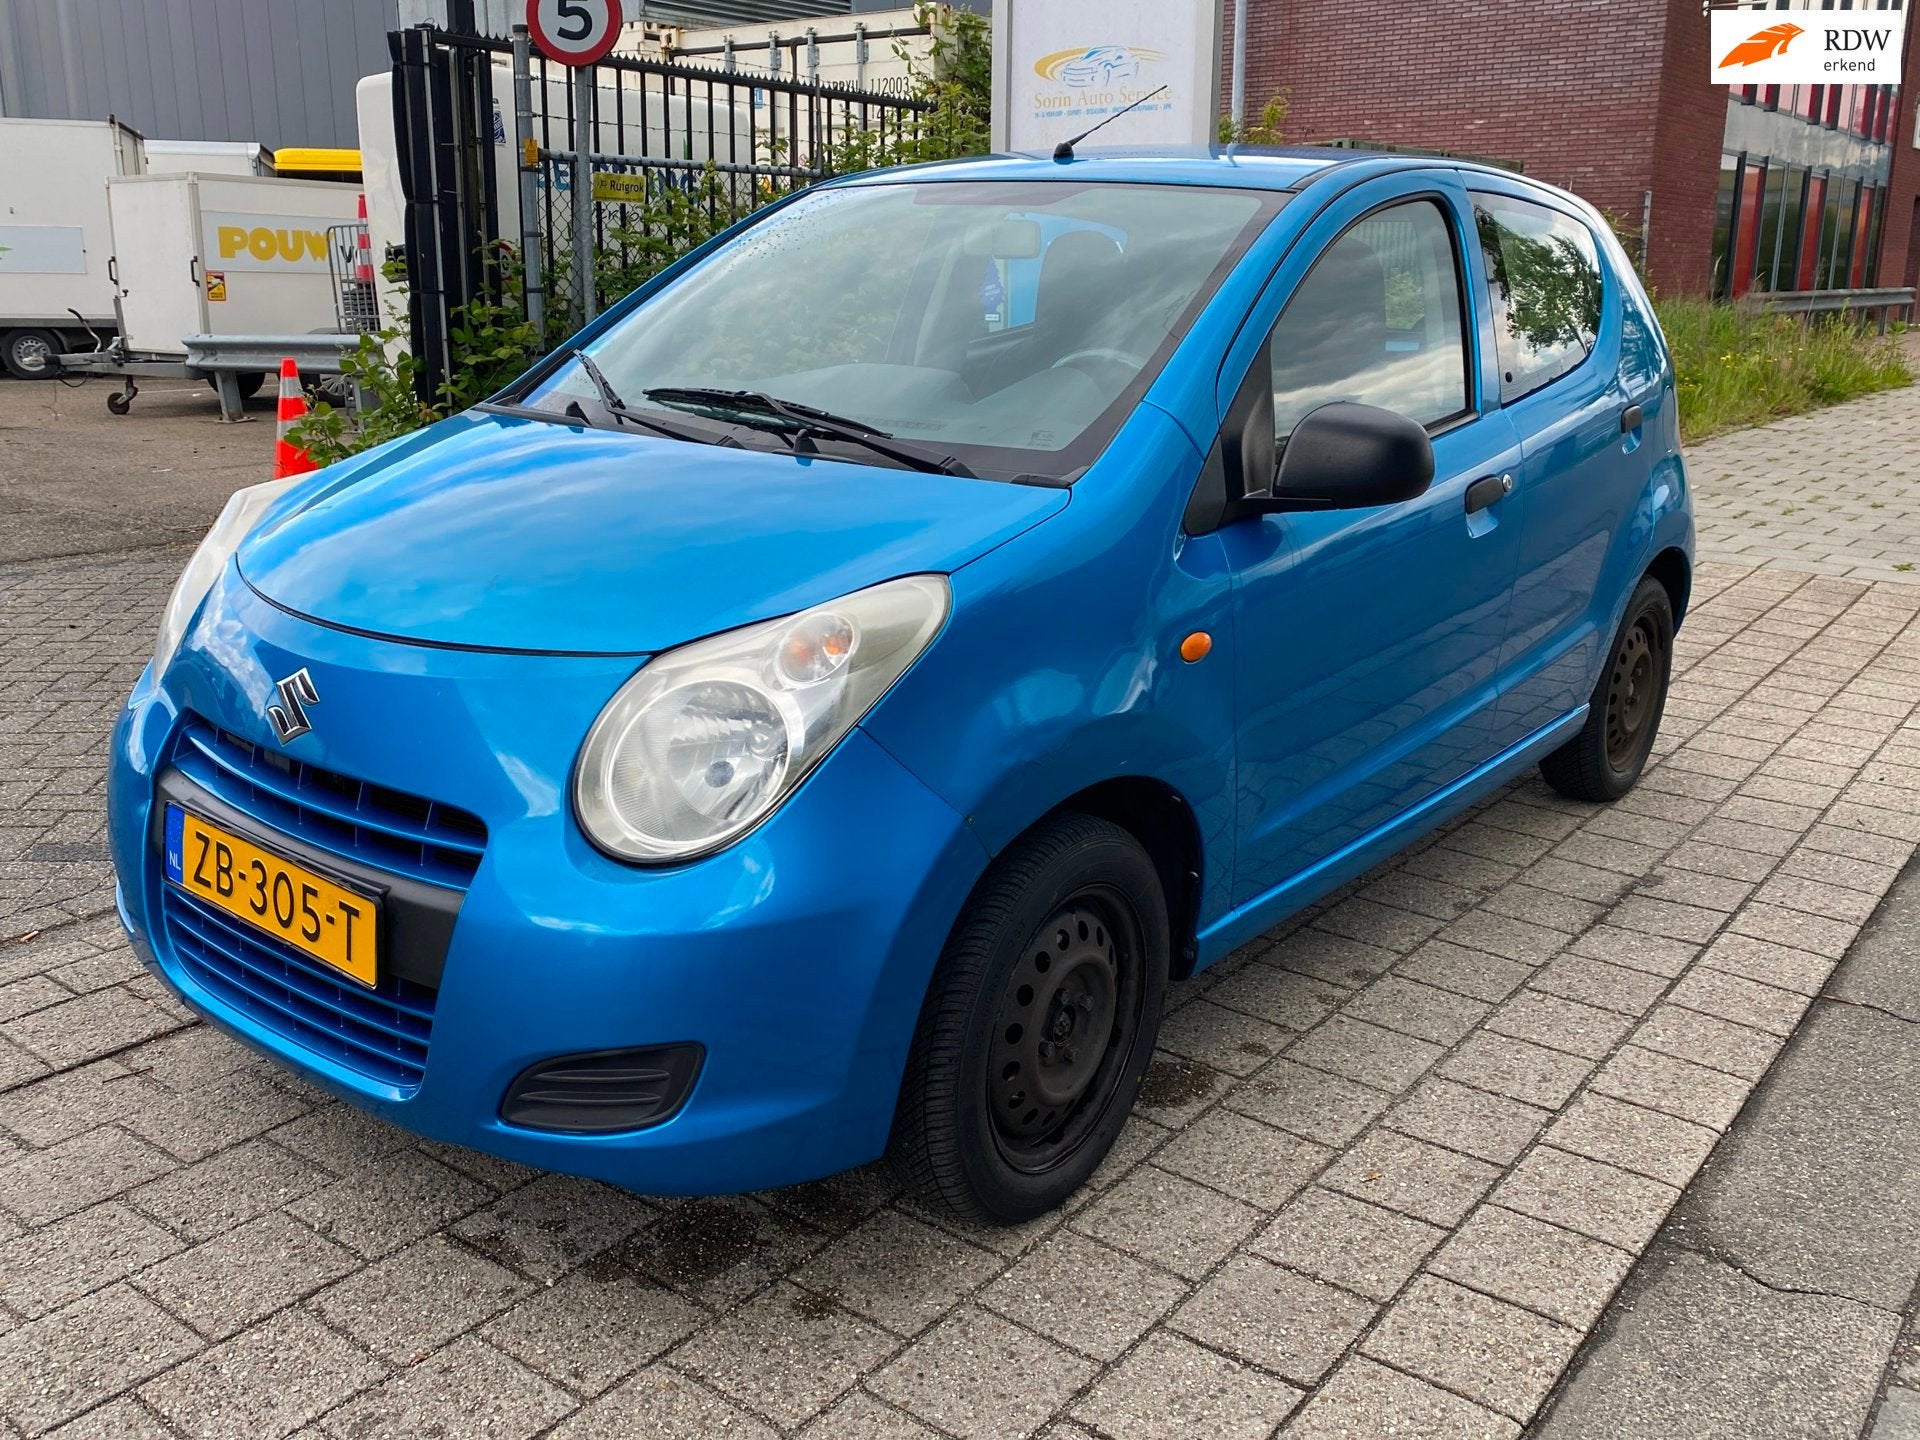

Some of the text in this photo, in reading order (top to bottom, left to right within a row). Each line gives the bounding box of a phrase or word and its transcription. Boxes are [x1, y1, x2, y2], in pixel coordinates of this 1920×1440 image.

[557, 0, 593, 40] 5
[1034, 84, 1172, 109] Sorin Auto Service
[609, 180, 645, 195] Ruigrok
[168, 829, 360, 963] NL ZB-305-T
